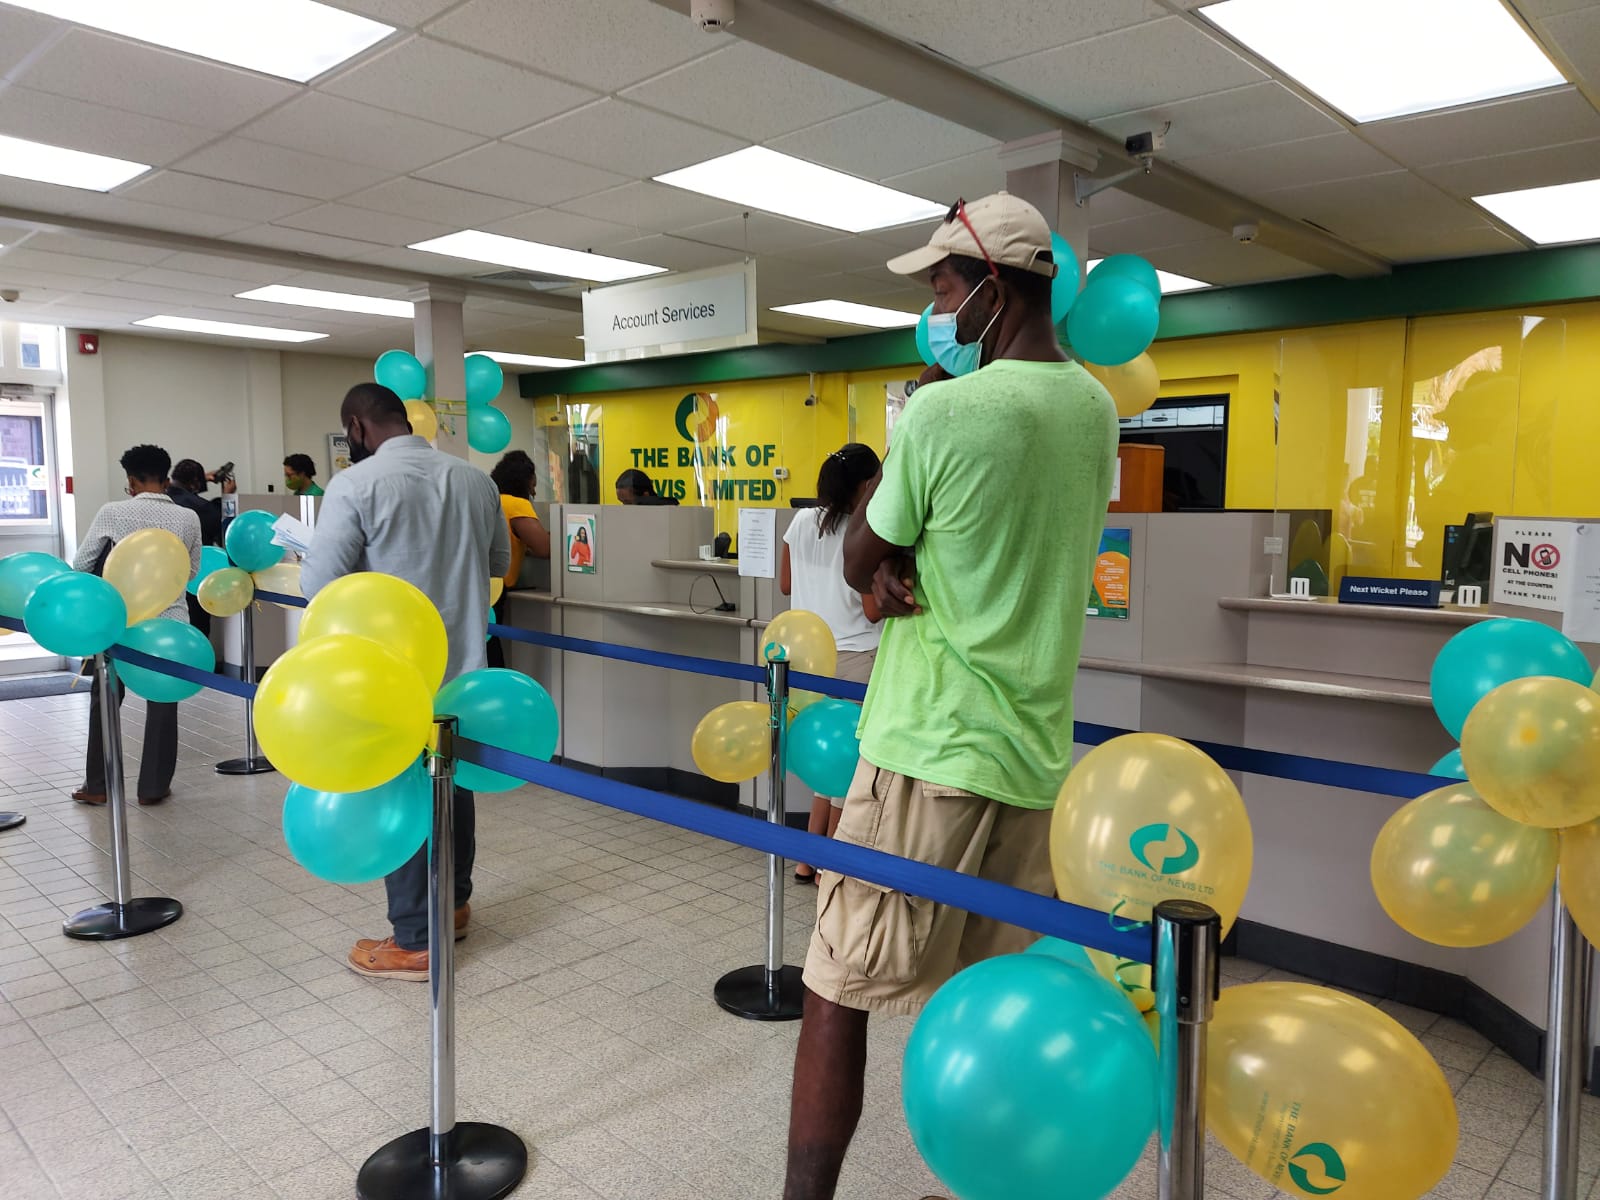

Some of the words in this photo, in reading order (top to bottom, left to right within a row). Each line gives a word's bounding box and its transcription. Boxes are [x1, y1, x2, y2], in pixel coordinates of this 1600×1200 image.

[612, 312, 659, 331] Account
[662, 302, 716, 324] Services
[630, 448, 669, 468] THE
[677, 445, 736, 468] BANK
[745, 444, 776, 467] OF
[651, 480, 686, 501] VIS
[1523, 570, 1558, 579] PHONES!
[1350, 585, 1369, 593] Next
[1370, 586, 1398, 595] Wicket
[1400, 587, 1429, 597] Please
[1503, 589, 1528, 597] THANK
[1098, 860, 1116, 872] THE
[1119, 865, 1147, 879] BANK
[1151, 873, 1163, 882] OF
[1167, 877, 1196, 891] NEVIS
[1198, 885, 1215, 896] LTD
[1290, 1102, 1301, 1120] THE
[1282, 1123, 1296, 1151] BANK
